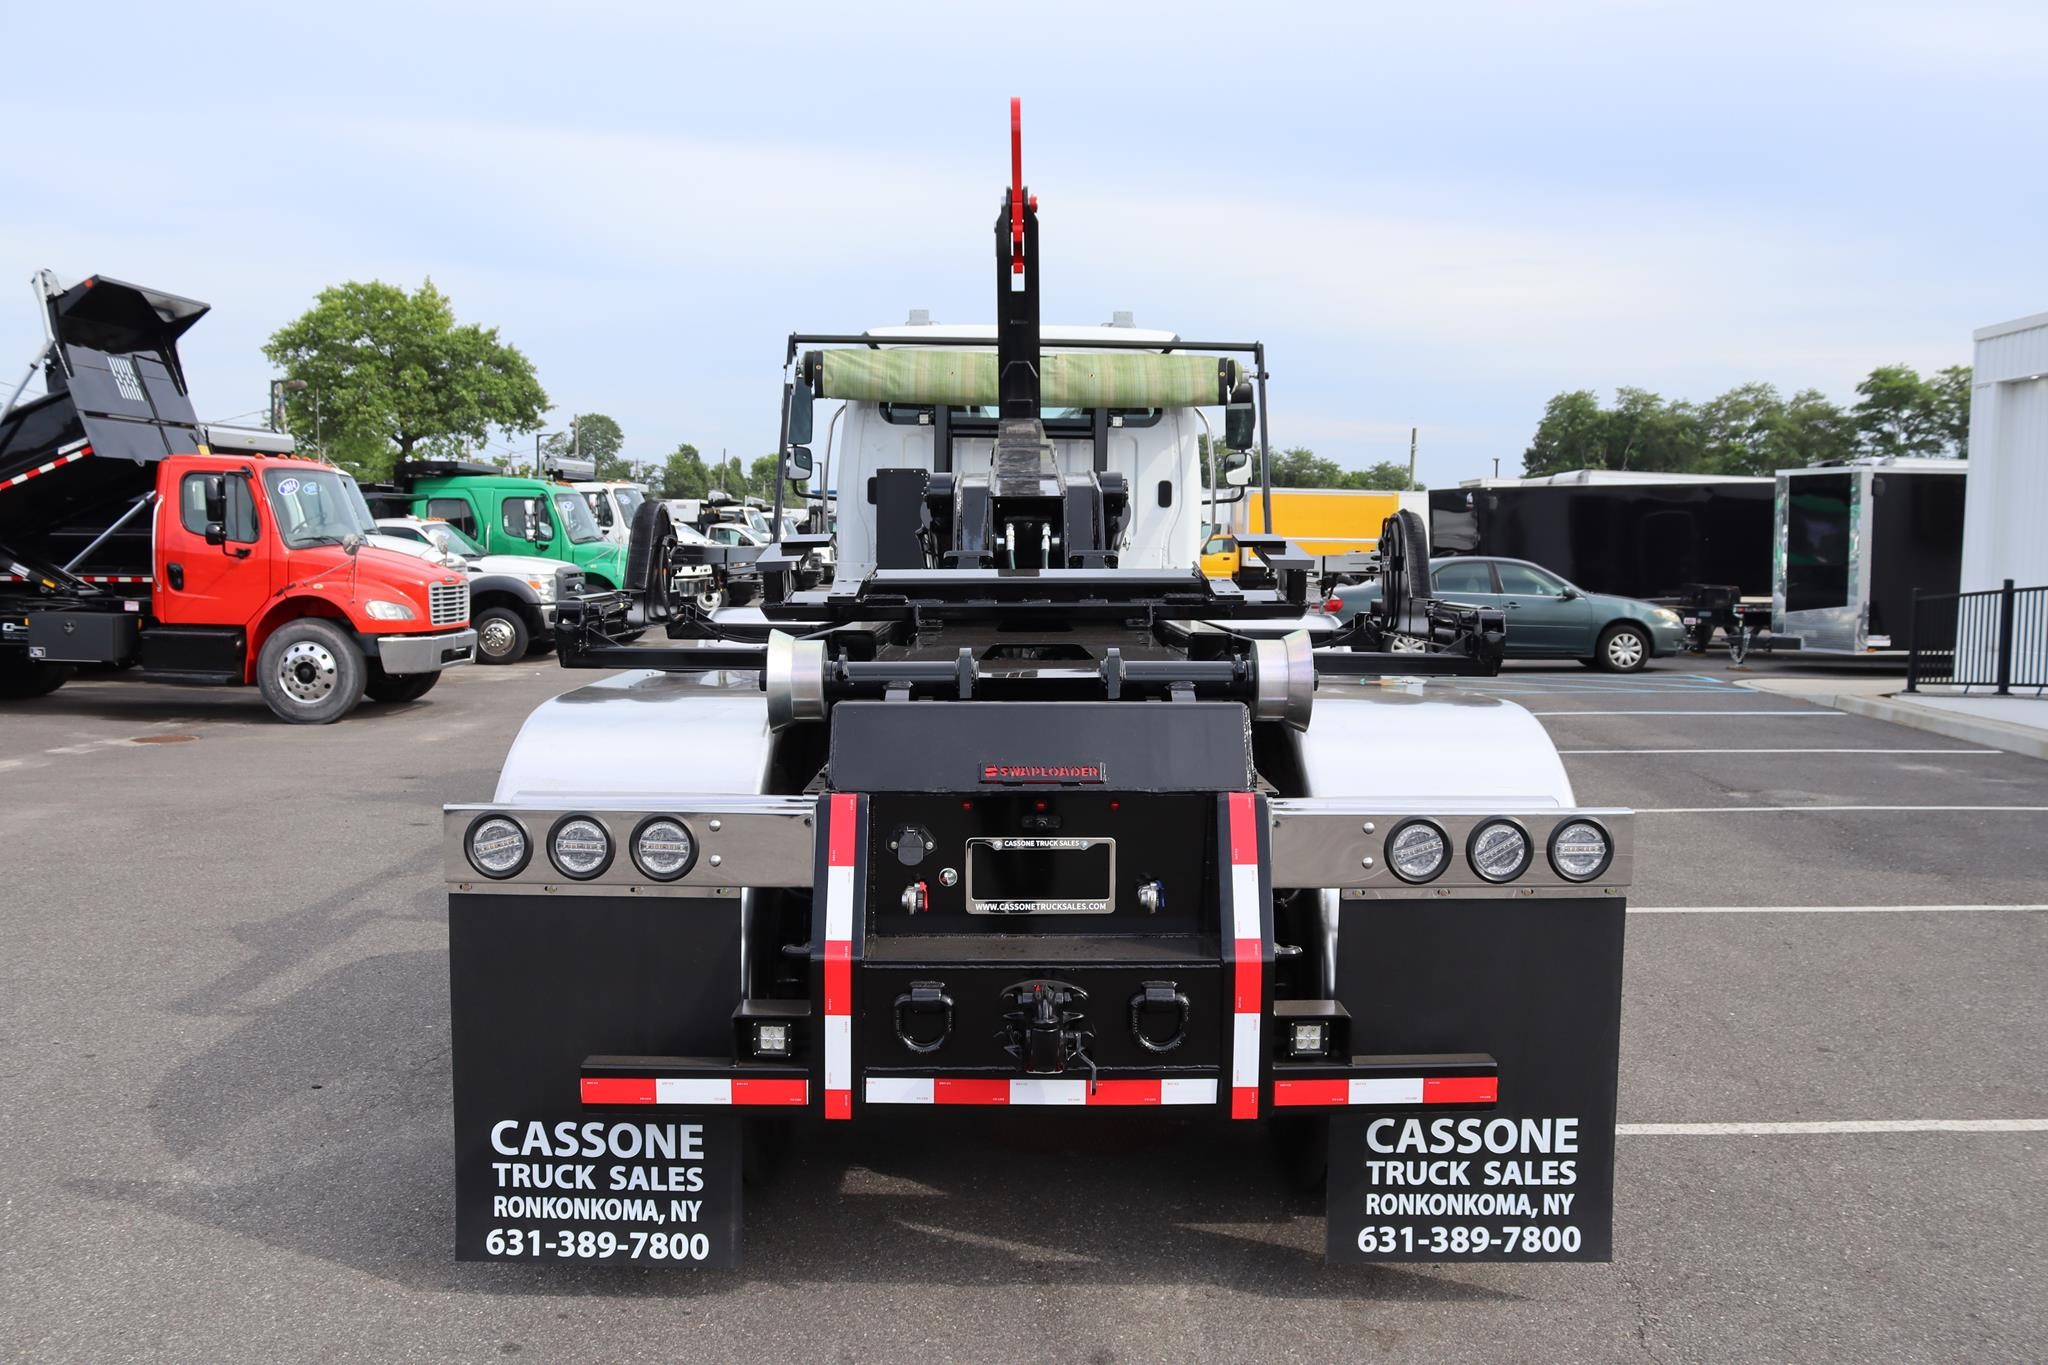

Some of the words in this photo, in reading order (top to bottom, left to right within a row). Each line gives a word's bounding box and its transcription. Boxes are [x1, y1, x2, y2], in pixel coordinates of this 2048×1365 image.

[1000, 765, 1098, 777] SWAPLOADER
[1004, 839, 1035, 847] CASSONE
[1036, 839, 1058, 847] TRUCK
[1059, 839, 1080, 847] SALES
[975, 902, 1107, 911] WWW.CASSONETRUCKSALES.COM
[490, 1119, 705, 1160] CASSONE
[1366, 1117, 1579, 1154] CASSONE
[491, 1162, 597, 1190] TRUCK
[609, 1165, 704, 1192] SALES
[1366, 1160, 1471, 1186] TRUCK
[1483, 1160, 1577, 1186] SALES
[493, 1195, 666, 1226] RONKONKOMA,
[670, 1199, 703, 1223] NY
[1365, 1193, 1539, 1219] RONKONKOMA,
[1543, 1193, 1576, 1216] NY
[485, 1228, 710, 1261] 631-389-7800
[1357, 1225, 1582, 1254] 631-389-7800
